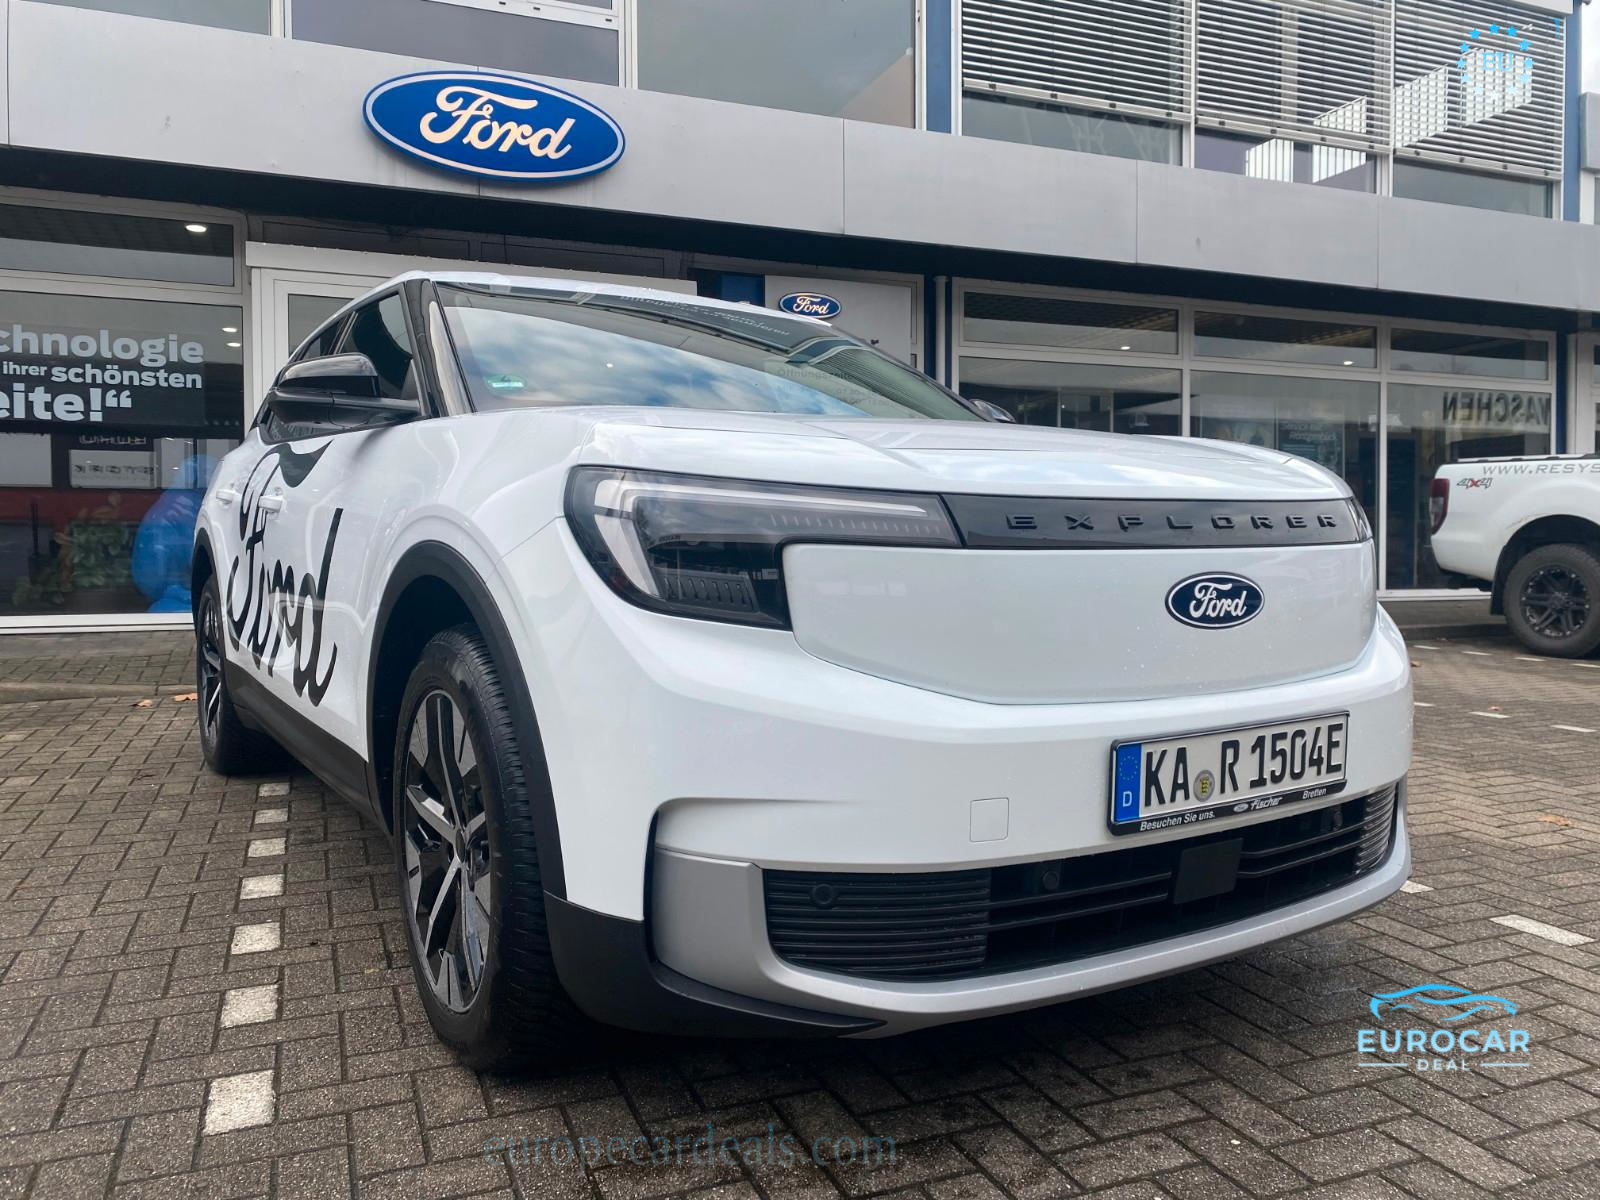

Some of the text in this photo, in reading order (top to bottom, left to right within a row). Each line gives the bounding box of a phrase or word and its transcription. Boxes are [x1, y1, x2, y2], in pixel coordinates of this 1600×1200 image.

[419, 85, 576, 160] Ford
[793, 296, 830, 314] Ford
[3, 361, 202, 389] ihrer schönsten
[1006, 514, 1337, 533] EXPLORER
[227, 442, 344, 707] Ford
[1189, 582, 1247, 618] Ford
[1144, 723, 1343, 807] KA R 1504E
[1122, 790, 1132, 808] D
[1302, 787, 1327, 800] Bretten
[1140, 810, 1216, 831] Besuchen Sie uns.
